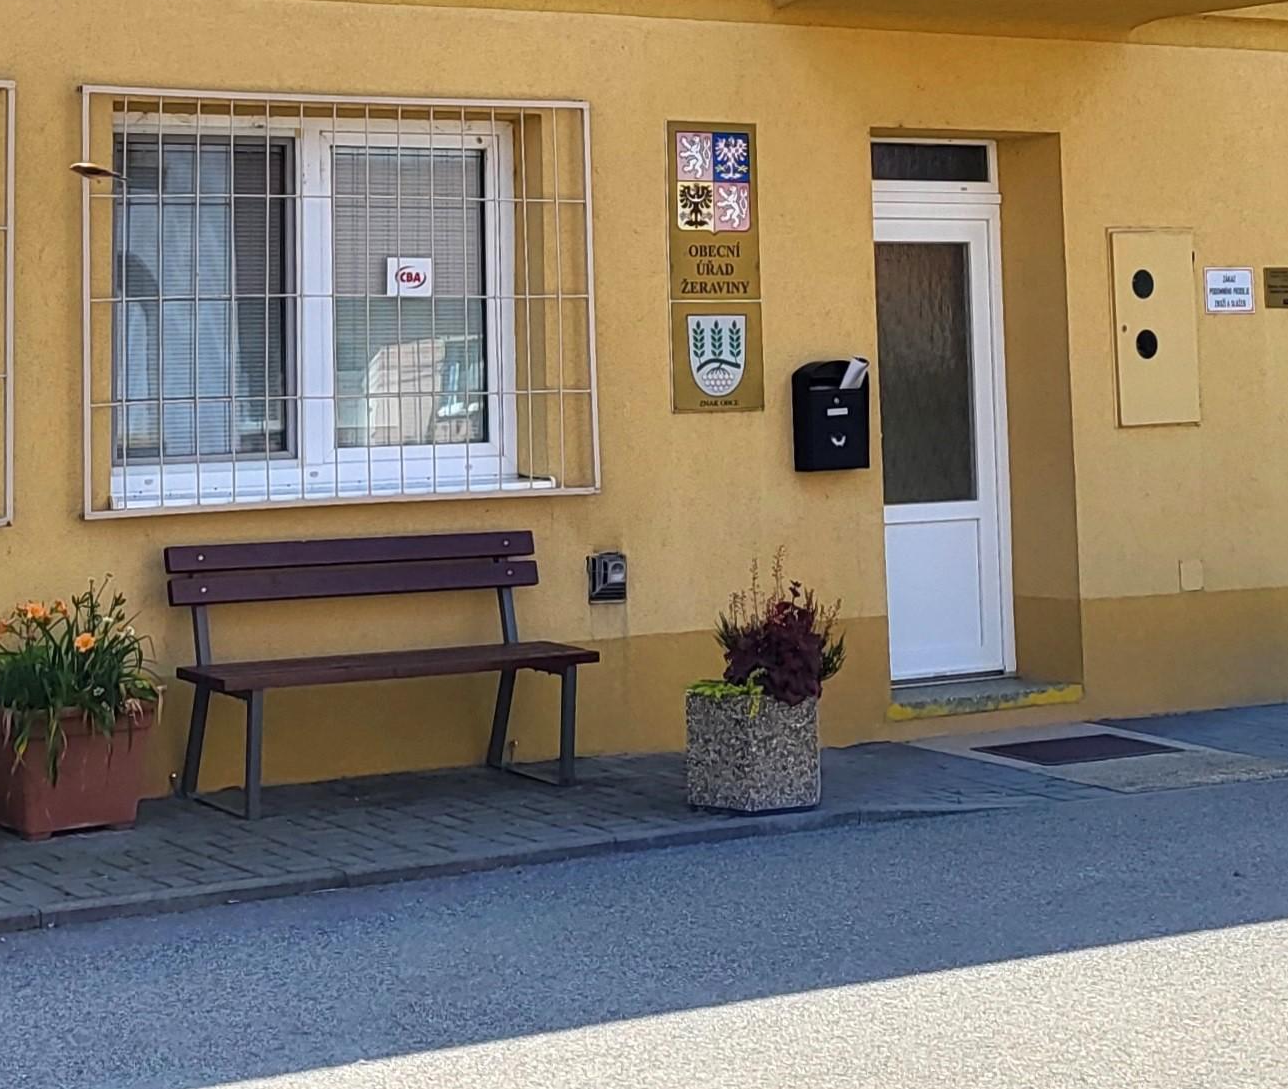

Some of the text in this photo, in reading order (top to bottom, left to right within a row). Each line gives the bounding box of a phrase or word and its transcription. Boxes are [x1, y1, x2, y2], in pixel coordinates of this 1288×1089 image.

[688, 241, 740, 258] OBECNÍ
[696, 259, 734, 276] ÚŘAD
[399, 271, 421, 283] CBA
[680, 278, 750, 294] ŽERAVINY
